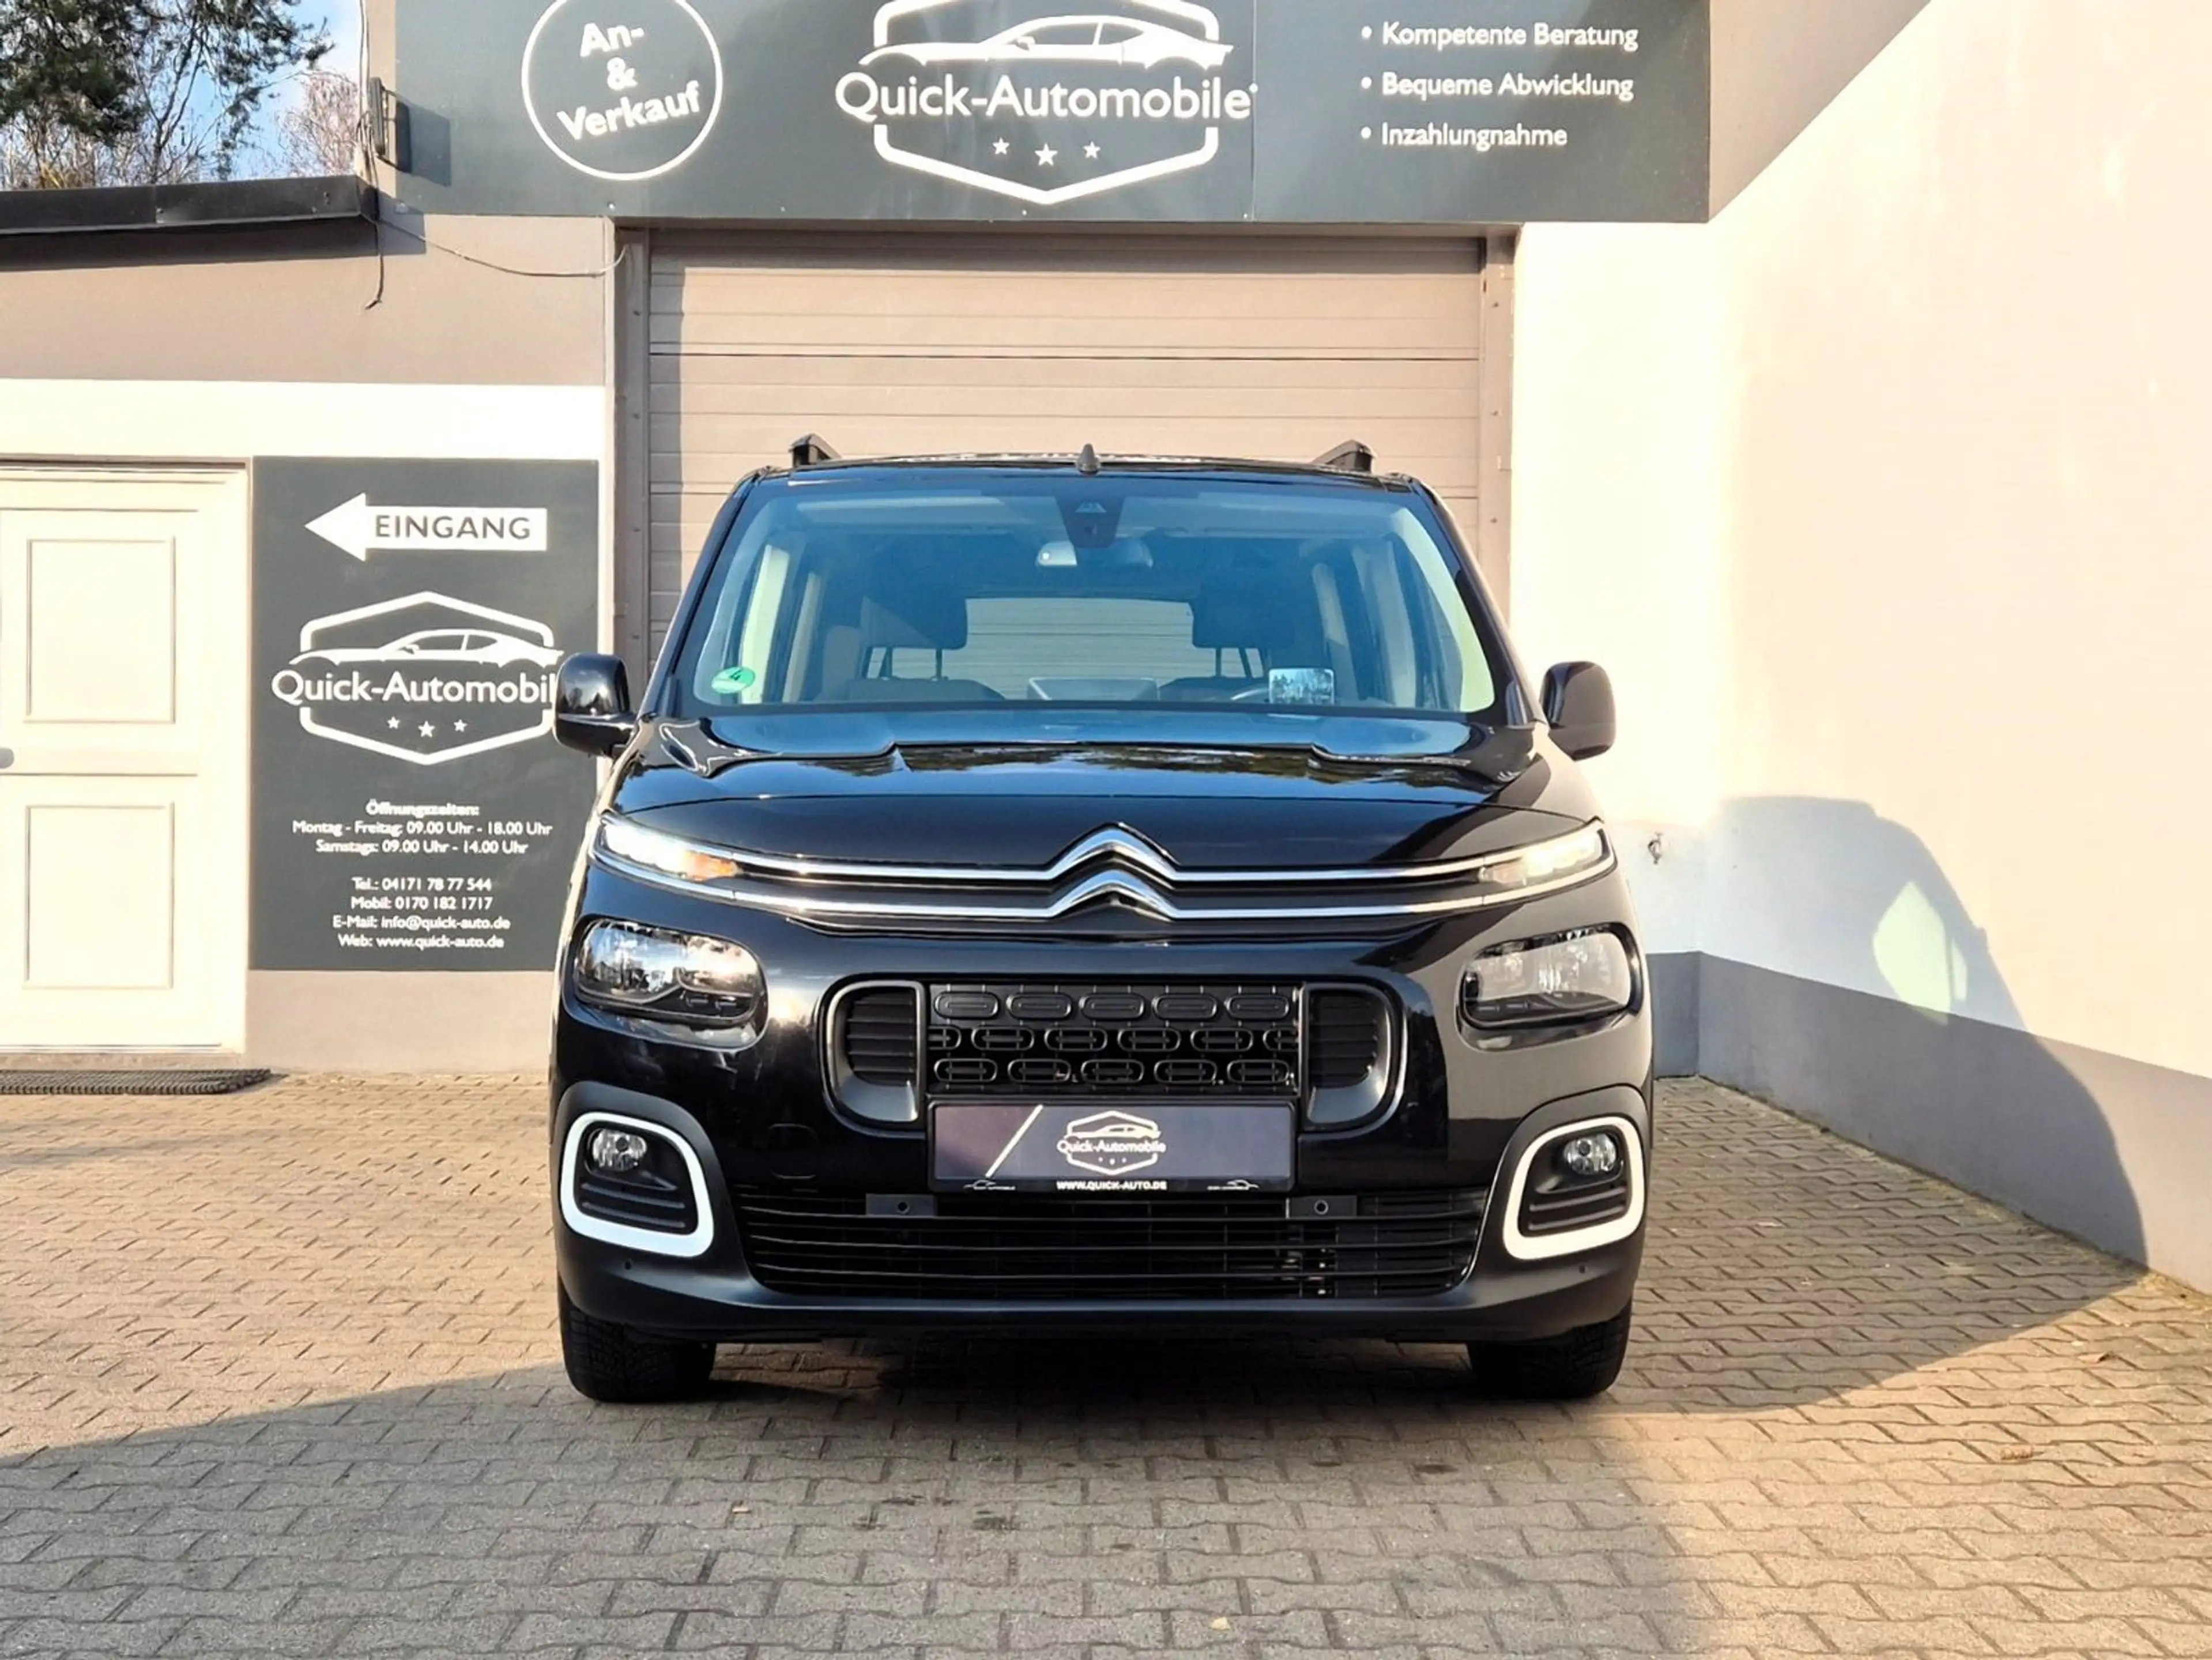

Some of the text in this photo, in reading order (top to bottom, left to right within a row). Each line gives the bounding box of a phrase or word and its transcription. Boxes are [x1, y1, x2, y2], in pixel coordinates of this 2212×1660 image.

[580, 22, 645, 58] An-
[1382, 21, 1638, 52] Kompetente Beratung
[606, 57, 638, 91] &
[1382, 71, 1634, 102] Bequeme Abwicklung
[835, 71, 1251, 123] Quick-Automobile
[557, 80, 701, 141] Verkauf
[1382, 122, 1567, 152] Inzahlungnahme
[375, 515, 530, 540] EINGANG
[272, 670, 557, 705] Quick-Automobil
[292, 820, 343, 837] Montag
[406, 820, 444, 835] 09.00
[447, 821, 474, 835] Uhr
[488, 821, 523, 835] 18.00
[526, 821, 553, 835] Uhr
[382, 839, 420, 853] 09.00
[423, 840, 450, 853] Uhr
[463, 840, 499, 854] 14.00
[502, 840, 529, 854] Uhr
[351, 877, 492, 891] Tel.: 04171 78 77 544
[351, 896, 493, 910] Mobil: 0170 182 1717
[333, 915, 511, 932] E-Mail: info@quick-auto.de
[337, 934, 504, 951] Web: www.quick-auto.de
[1057, 1140, 1166, 1154] Quick-Automobile
[1056, 1180, 1167, 1191] WWW.QUICK-AUTO.DE
